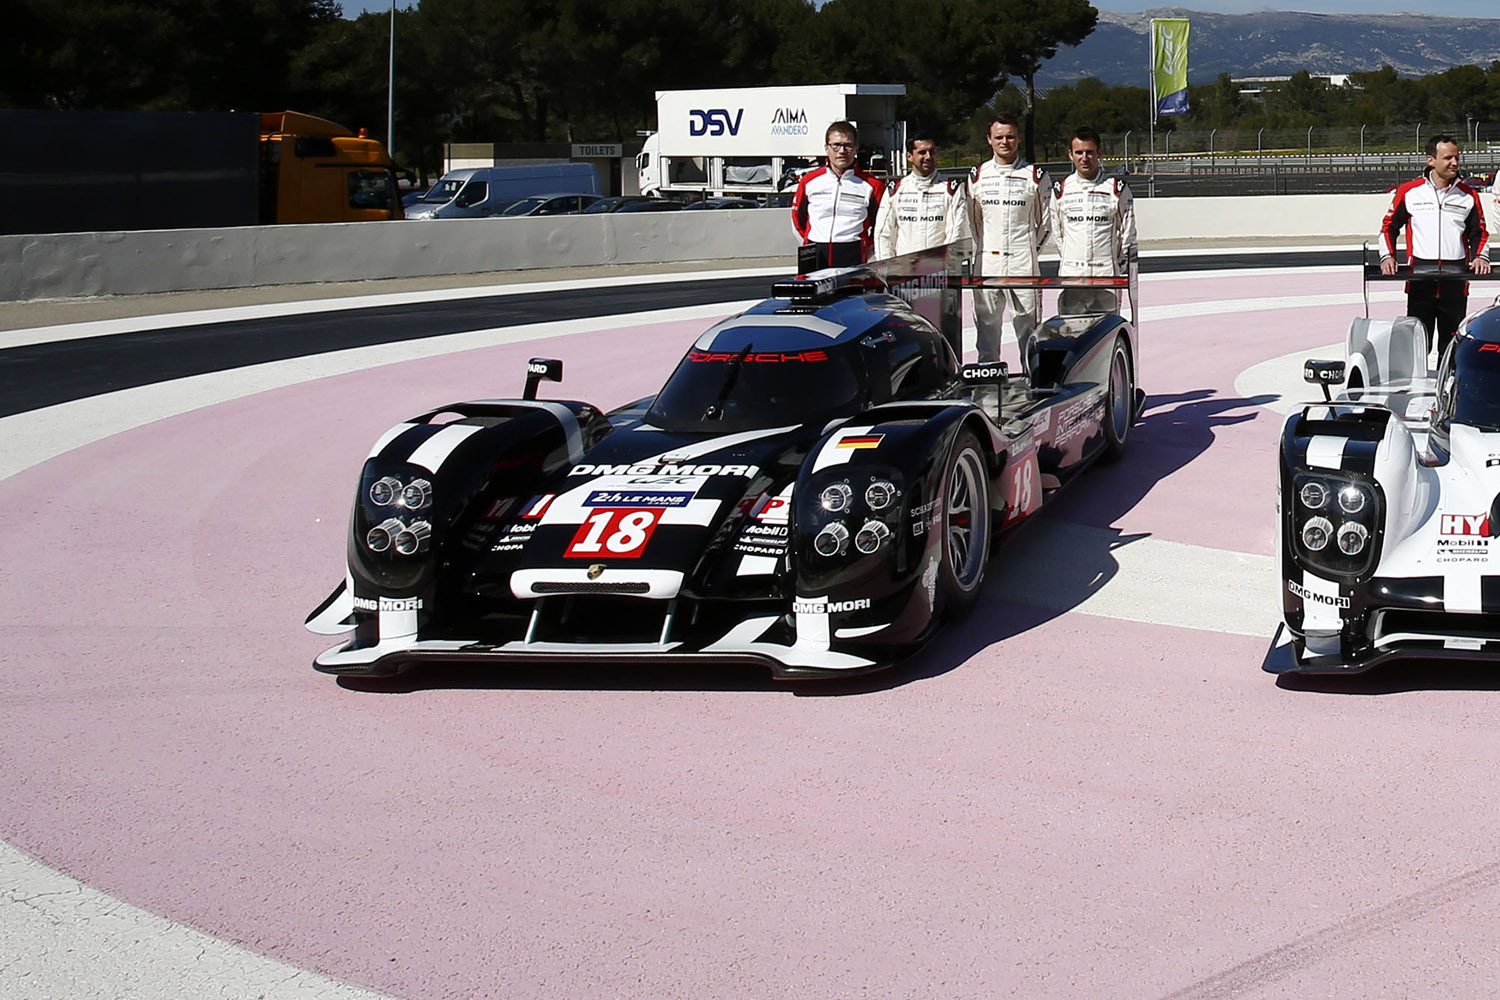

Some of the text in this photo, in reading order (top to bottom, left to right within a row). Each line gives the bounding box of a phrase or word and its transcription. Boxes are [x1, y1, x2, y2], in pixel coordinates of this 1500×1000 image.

[690, 109, 744, 136] DSV
[771, 107, 808, 124] SAIMA
[771, 125, 808, 135] AVANDERO
[579, 145, 615, 155] TOILETS
[920, 270, 948, 298] MORI
[568, 464, 760, 479] DMG MORI
[627, 477, 697, 485] WEC
[1009, 459, 1032, 520] 18
[571, 510, 655, 553] 18
[1442, 512, 1487, 535] HY
[1288, 580, 1349, 607] DMG MORI
[354, 596, 423, 612] DMG MORI
[793, 598, 871, 614] DMG MORI
